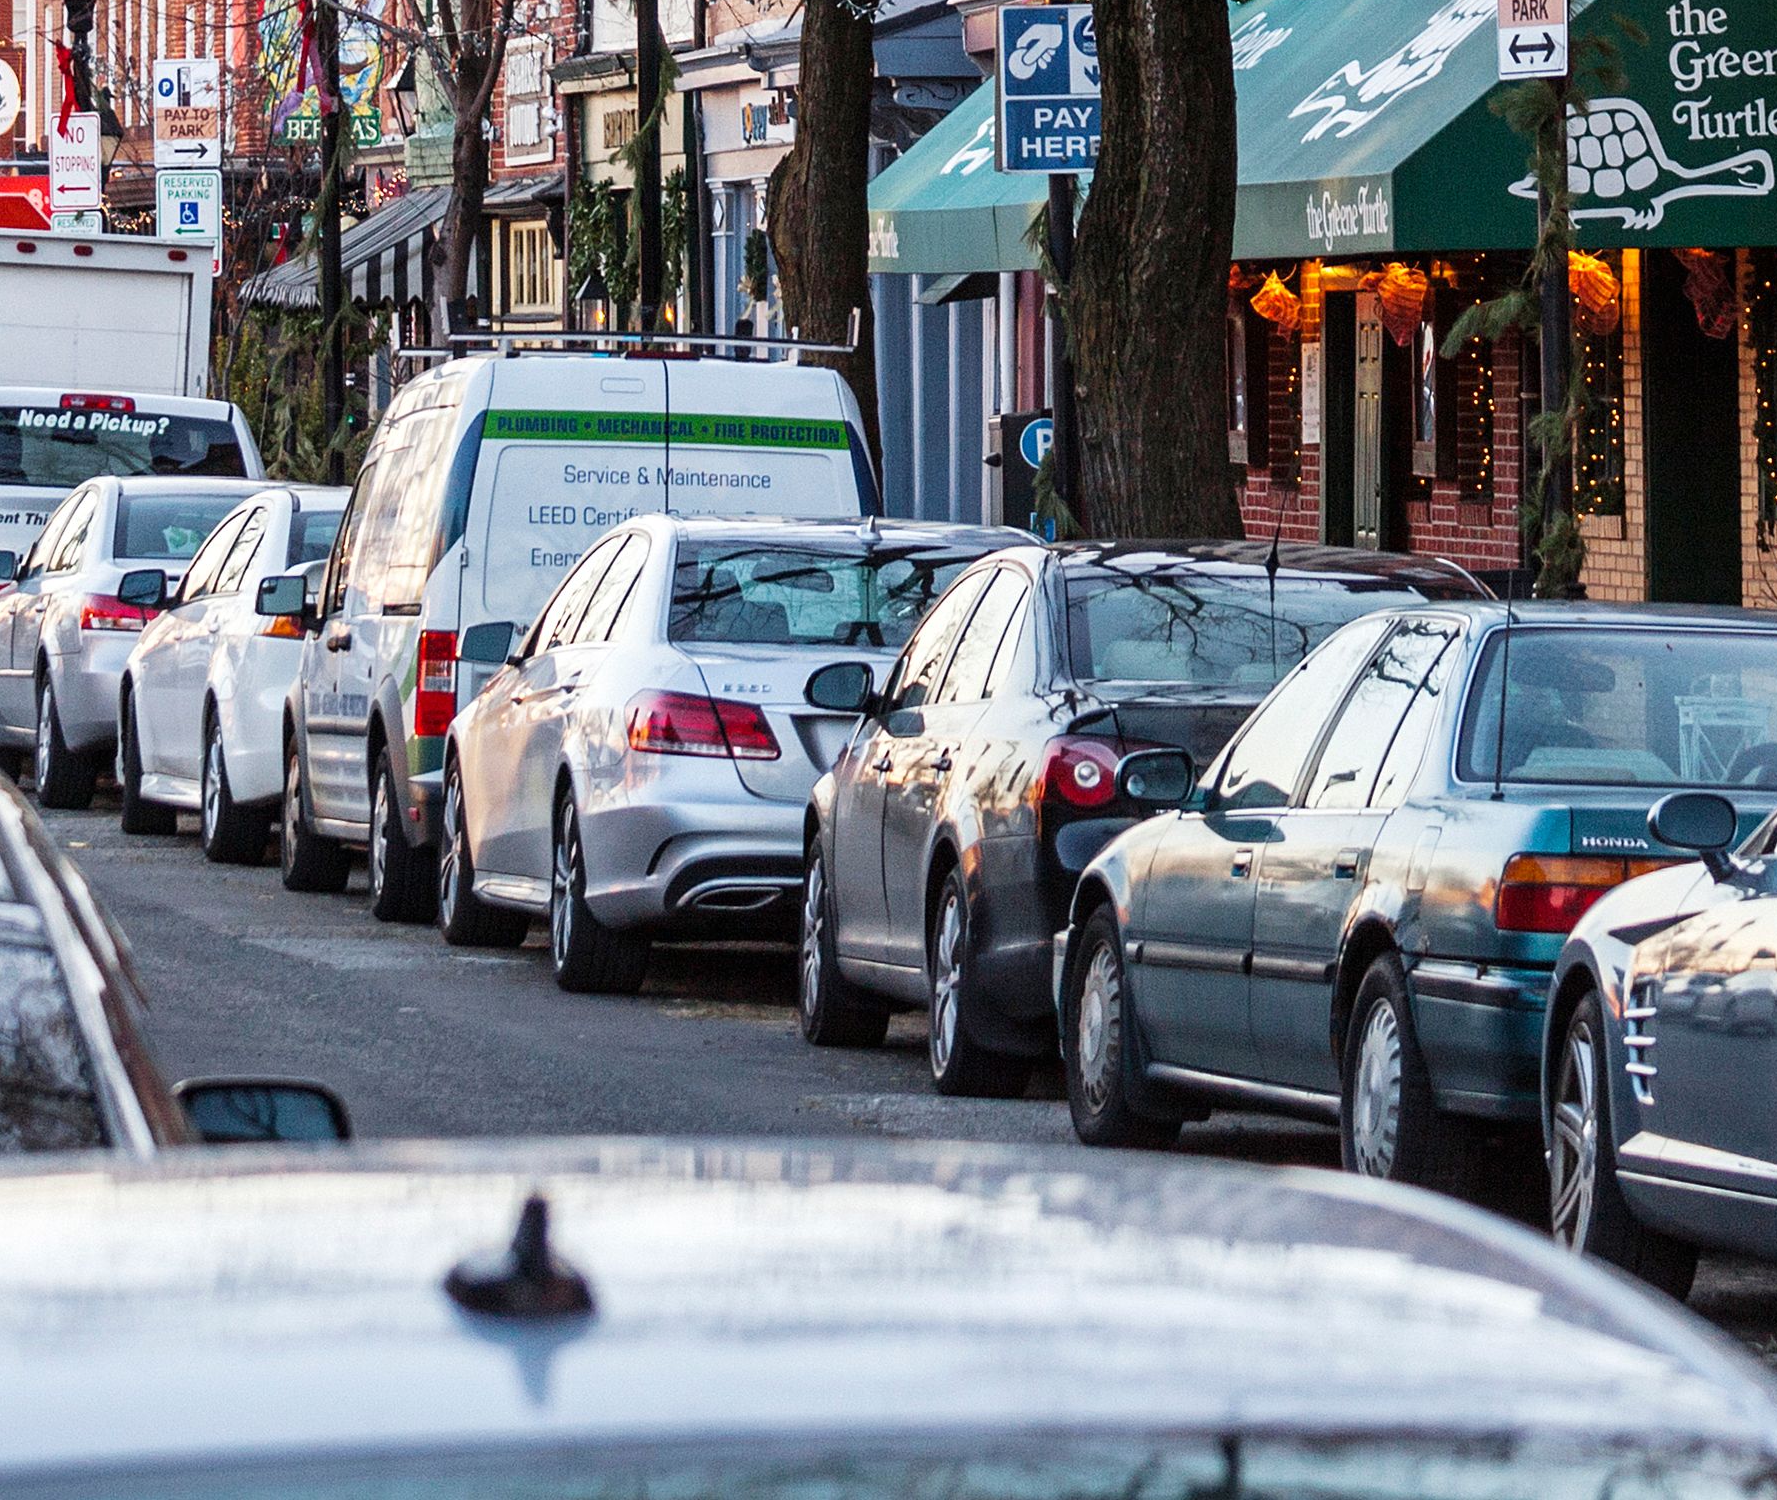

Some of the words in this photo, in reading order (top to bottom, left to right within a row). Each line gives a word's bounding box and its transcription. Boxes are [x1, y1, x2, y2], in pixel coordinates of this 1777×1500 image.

[164, 108, 189, 121] PAY
[193, 107, 210, 121] TO
[1034, 107, 1093, 129] PAY
[65, 126, 85, 144] NO
[170, 124, 204, 137] PARK
[287, 118, 377, 140] BEA'S
[1022, 135, 1102, 158] HERE
[55, 155, 95, 173] STOPPING
[163, 178, 214, 188] RESERVED
[167, 189, 210, 200] PARKING
[1306, 193, 1323, 240] the
[1322, 190, 1359, 253] Greene
[1358, 181, 1389, 236] Turtle
[18, 409, 72, 429] Need
[73, 415, 86, 429] a
[89, 411, 170, 437] Pickup?
[497, 415, 579, 434] PLUMBING
[597, 417, 695, 438] MECHANICAL
[714, 421, 745, 440] FIRE
[750, 423, 841, 443] PROTECTION
[1036, 427, 1055, 463] P
[563, 464, 631, 486] Service
[637, 466, 651, 486] &
[656, 466, 772, 489] Maintenance
[25, 513, 49, 527] Thi
[528, 505, 576, 525] LEED
[582, 505, 647, 526] Certif
[530, 547, 583, 567] Ener
[1582, 836, 1649, 850] HONDA
